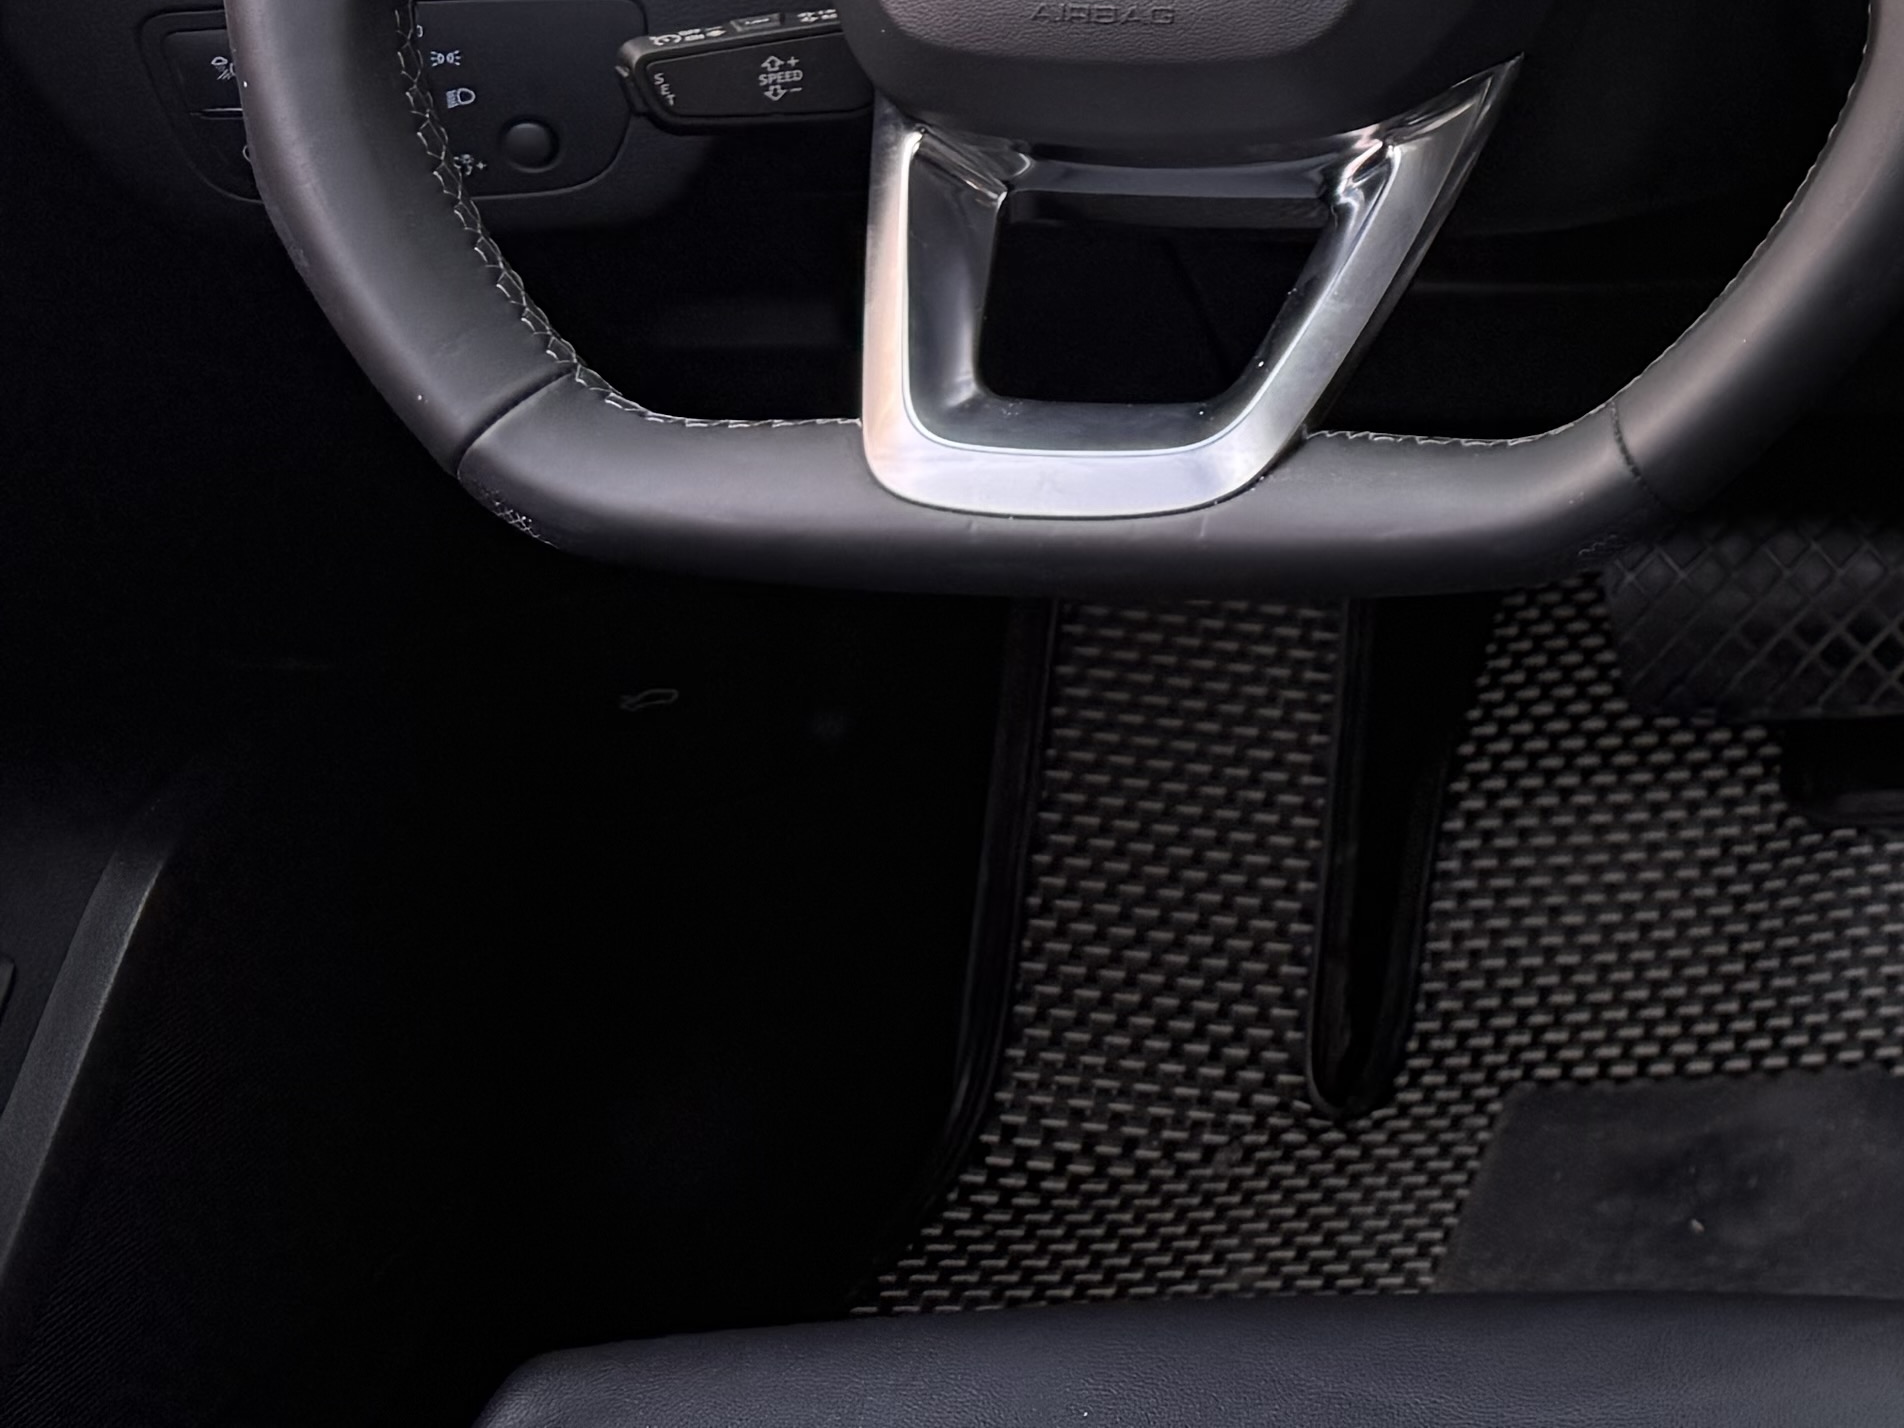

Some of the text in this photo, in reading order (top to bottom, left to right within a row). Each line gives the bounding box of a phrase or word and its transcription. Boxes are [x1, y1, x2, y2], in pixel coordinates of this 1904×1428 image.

[1031, 1, 1177, 27] AIRBAG
[653, 72, 676, 107] SET
[758, 68, 804, 87] SPEED
